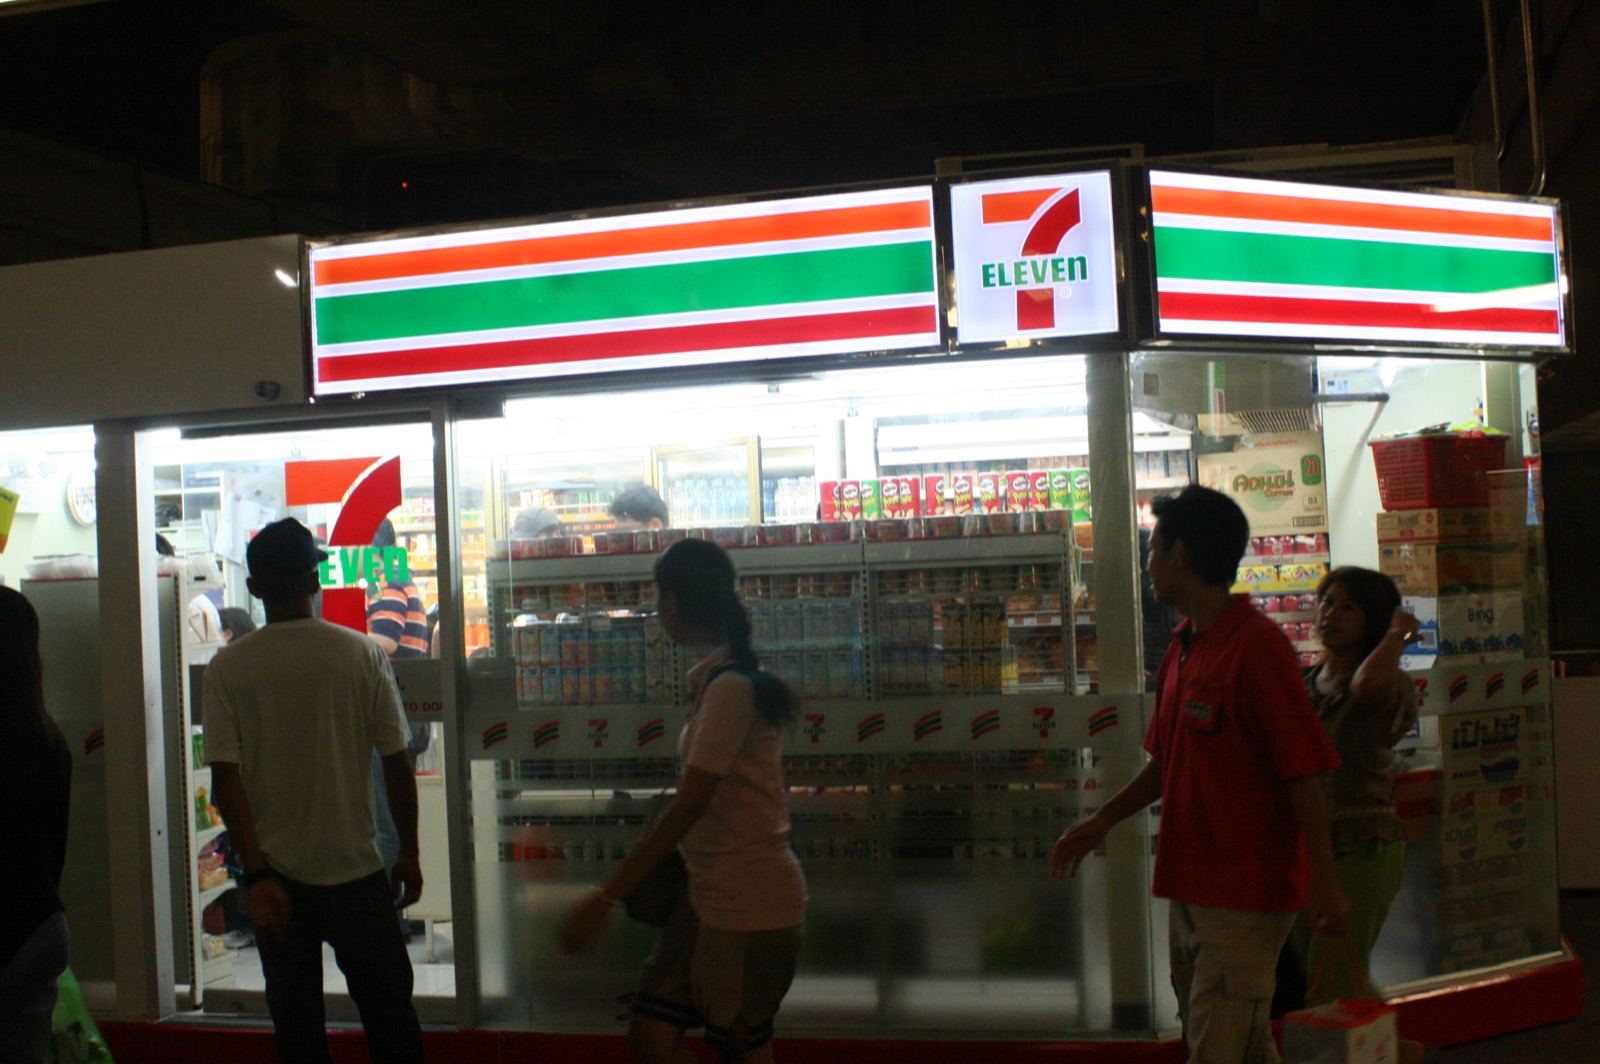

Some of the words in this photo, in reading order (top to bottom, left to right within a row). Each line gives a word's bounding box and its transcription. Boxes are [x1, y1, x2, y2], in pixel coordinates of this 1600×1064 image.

[981, 187, 1081, 331] 7
[1303, 458, 1319, 477] 20
[285, 455, 402, 635] 7
[319, 545, 409, 585] EVEn
[1468, 607, 1494, 624] Bing
